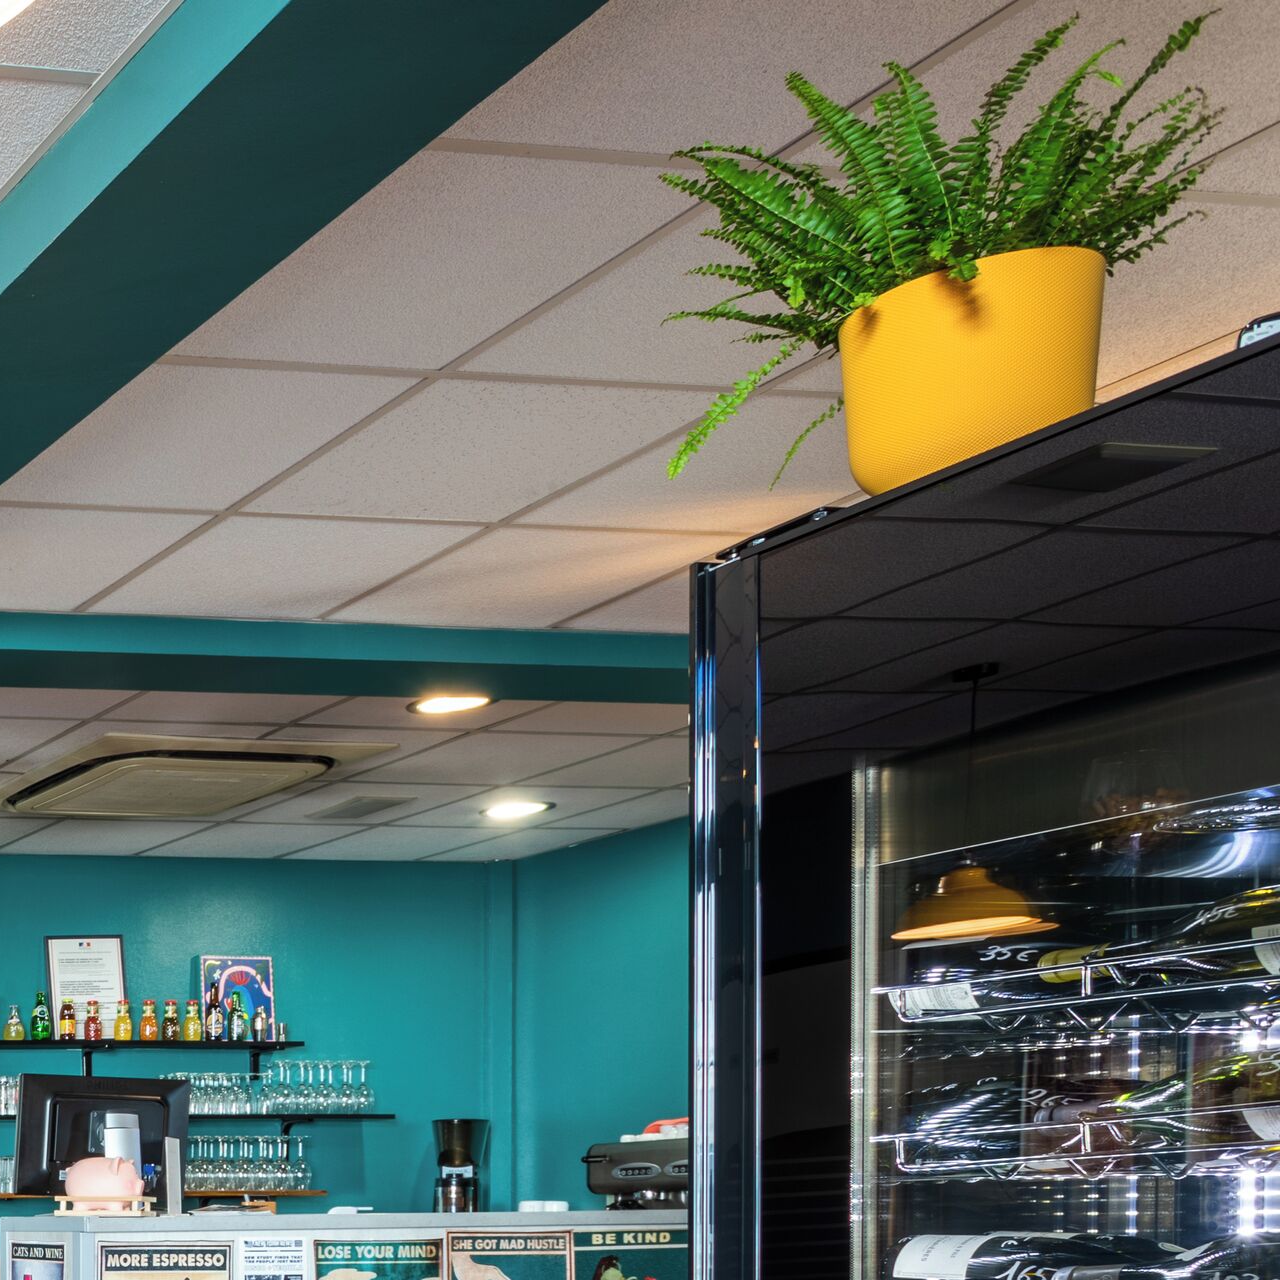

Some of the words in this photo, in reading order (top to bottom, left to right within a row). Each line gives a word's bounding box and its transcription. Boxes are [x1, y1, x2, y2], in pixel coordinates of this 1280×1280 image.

[980, 945, 1040, 962] 35€
[453, 1238, 474, 1251] SHE
[476, 1238, 497, 1250] GOT
[499, 1238, 524, 1249] MAD
[526, 1236, 566, 1249] HUSTLE
[592, 1232, 615, 1245] BE
[623, 1231, 671, 1244] KIND
[12, 1246, 28, 1258] CATS
[29, 1247, 44, 1258] AND
[45, 1247, 64, 1259] WINE
[317, 1245, 352, 1259] LOSE
[354, 1245, 394, 1259] YOUR
[398, 1244, 437, 1258] MIND
[107, 1254, 148, 1267] MORE
[153, 1253, 225, 1267] ESPRESSO
